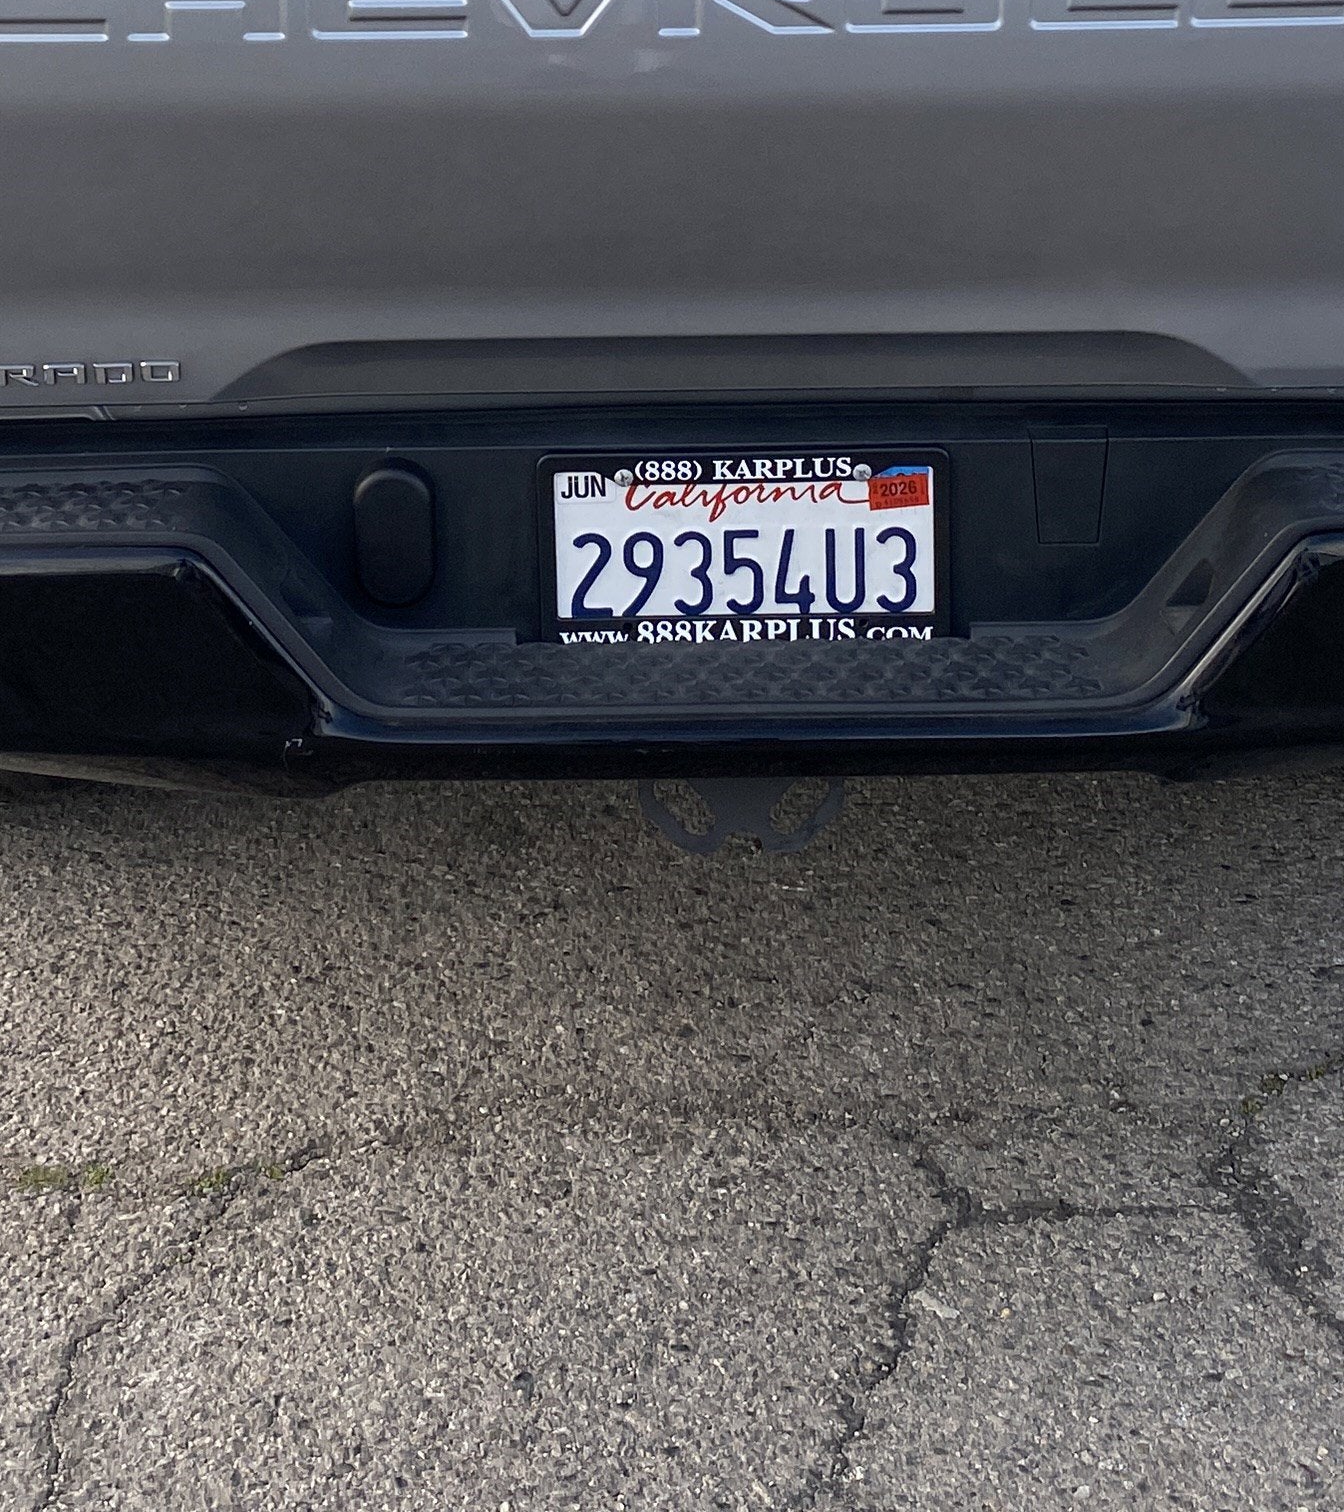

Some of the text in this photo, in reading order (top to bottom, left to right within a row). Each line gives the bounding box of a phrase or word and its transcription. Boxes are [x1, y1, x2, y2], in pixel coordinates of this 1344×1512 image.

[634, 456, 852, 481] (888) KARPLUS
[561, 475, 870, 523] JUN California
[879, 480, 918, 497] 2026
[571, 526, 918, 617] 29354U3
